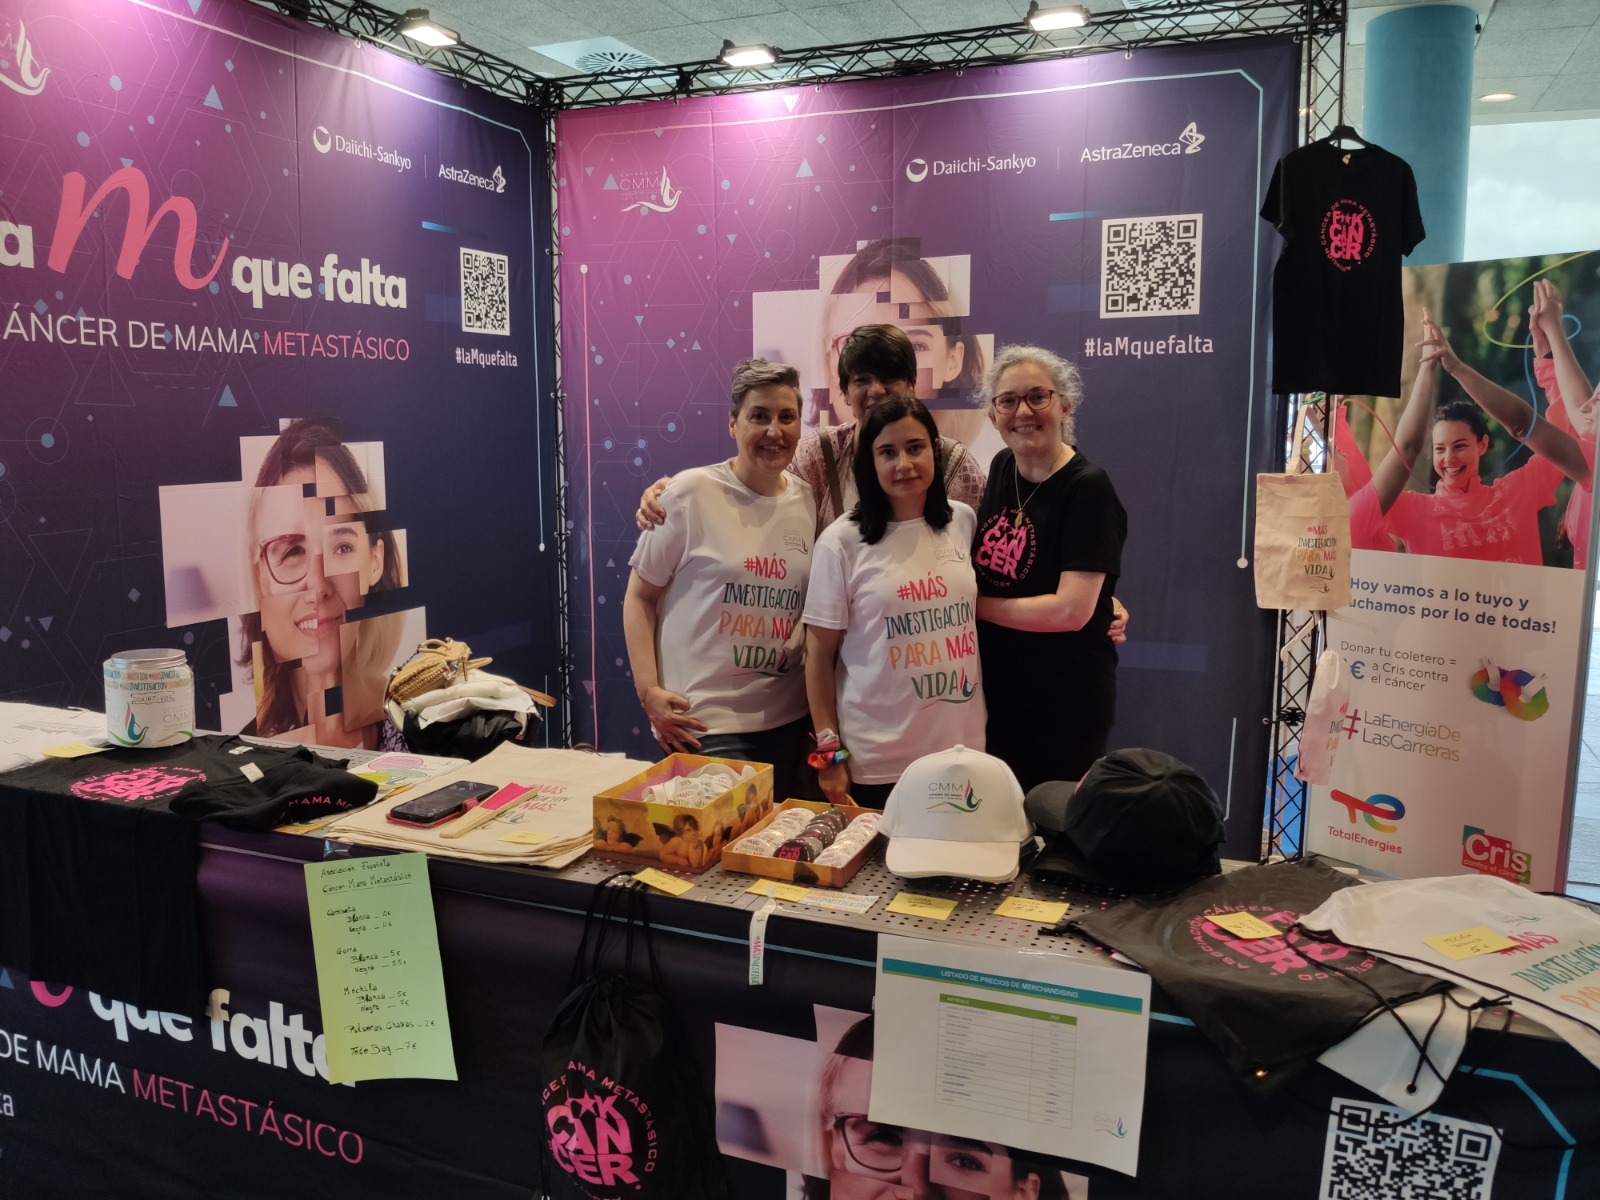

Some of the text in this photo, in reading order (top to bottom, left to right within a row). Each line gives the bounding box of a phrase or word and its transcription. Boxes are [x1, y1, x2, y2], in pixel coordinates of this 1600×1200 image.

[335, 135, 411, 172] Daiichi-Sankyo
[933, 153, 1036, 176] Daiichi-Sankyo
[1080, 142, 1181, 163] AstraZeneca
[438, 164, 495, 192] AstraZeneca
[0, 221, 34, 268] a
[232, 256, 313, 309] que
[320, 253, 407, 309] falta
[0, 302, 410, 361] ÁNCER DE MAMA METASTÁSICO
[455, 347, 518, 368] #laMquefalta
[1084, 334, 1213, 359] #laMquefalta
[744, 553, 787, 581] #MÁS
[1304, 564, 1328, 575] VIDA
[897, 571, 948, 602] #MÁS
[1350, 577, 1529, 612] Hoy vamos a lo tuyo y
[719, 611, 766, 640] PARA
[885, 596, 974, 640] INVESTIGACIÓN
[1350, 599, 1556, 634] uchamos por lo de todas!
[733, 645, 777, 670] VIDA
[889, 627, 976, 671] PARA MÁS
[1341, 641, 1376, 655] Donar
[1379, 647, 1391, 658] tu
[1394, 649, 1445, 666] coletero
[911, 670, 959, 700] VIDA
[1371, 674, 1425, 691] el cáncer
[1372, 662, 1448, 682] a Cris contra
[1362, 727, 1461, 762] LasCarreras
[928, 782, 963, 792] CMM
[1327, 826, 1402, 854] TotalEnergies
[1465, 833, 1528, 873] Cris
[941, 970, 1079, 998] LISTADO DE PRECIOS DE MERCHANDISING
[206, 988, 355, 1088] falt
[36, 1040, 126, 1094] MAMA
[133, 1068, 364, 1164] METASTÁSICO
[567, 1060, 597, 1081] AMA
[601, 1076, 658, 1173] METASTÁSICO
